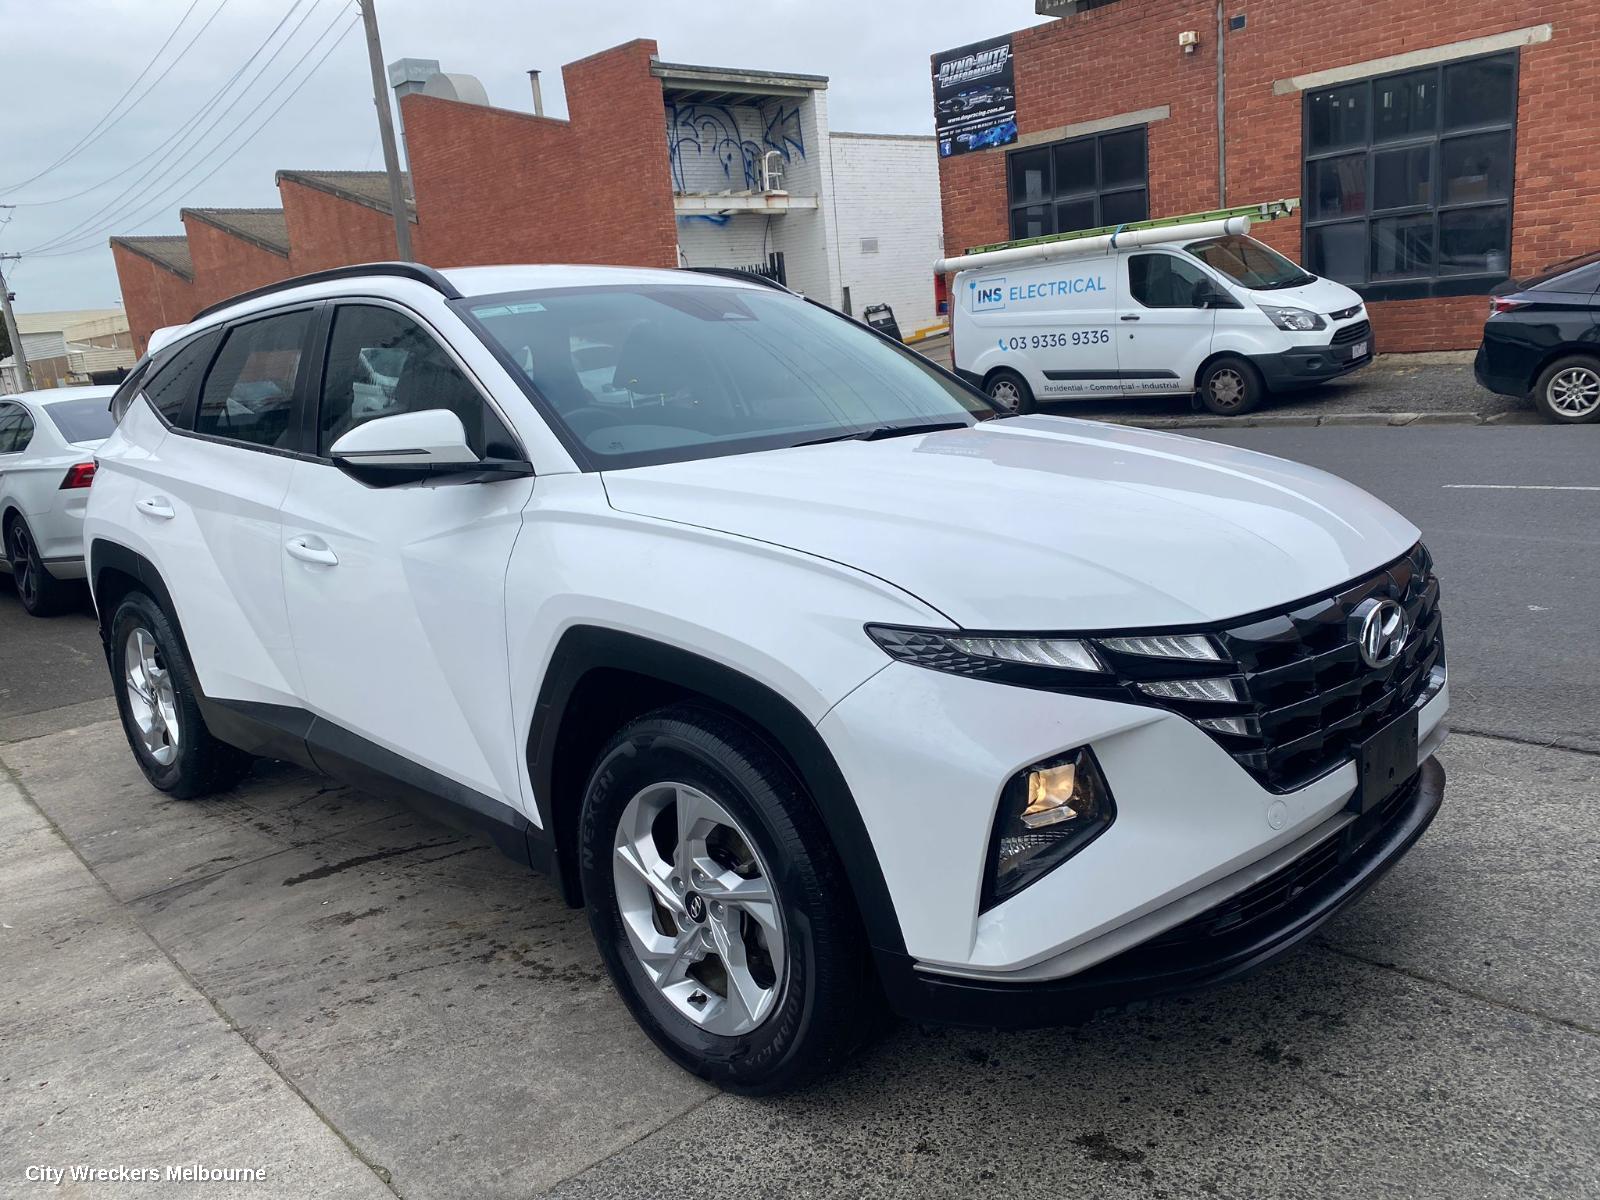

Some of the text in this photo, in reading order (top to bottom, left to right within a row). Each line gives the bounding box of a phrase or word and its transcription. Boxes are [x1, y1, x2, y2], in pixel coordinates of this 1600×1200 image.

[941, 46, 1008, 78] DYNO-MITE
[943, 62, 1003, 83] PERFORMANCE
[977, 276, 1106, 304] INS ELECTRICAL
[1009, 329, 1110, 350] 03 9336 9336
[1090, 383, 1135, 391] Commercial
[583, 769, 614, 870] NEXEN
